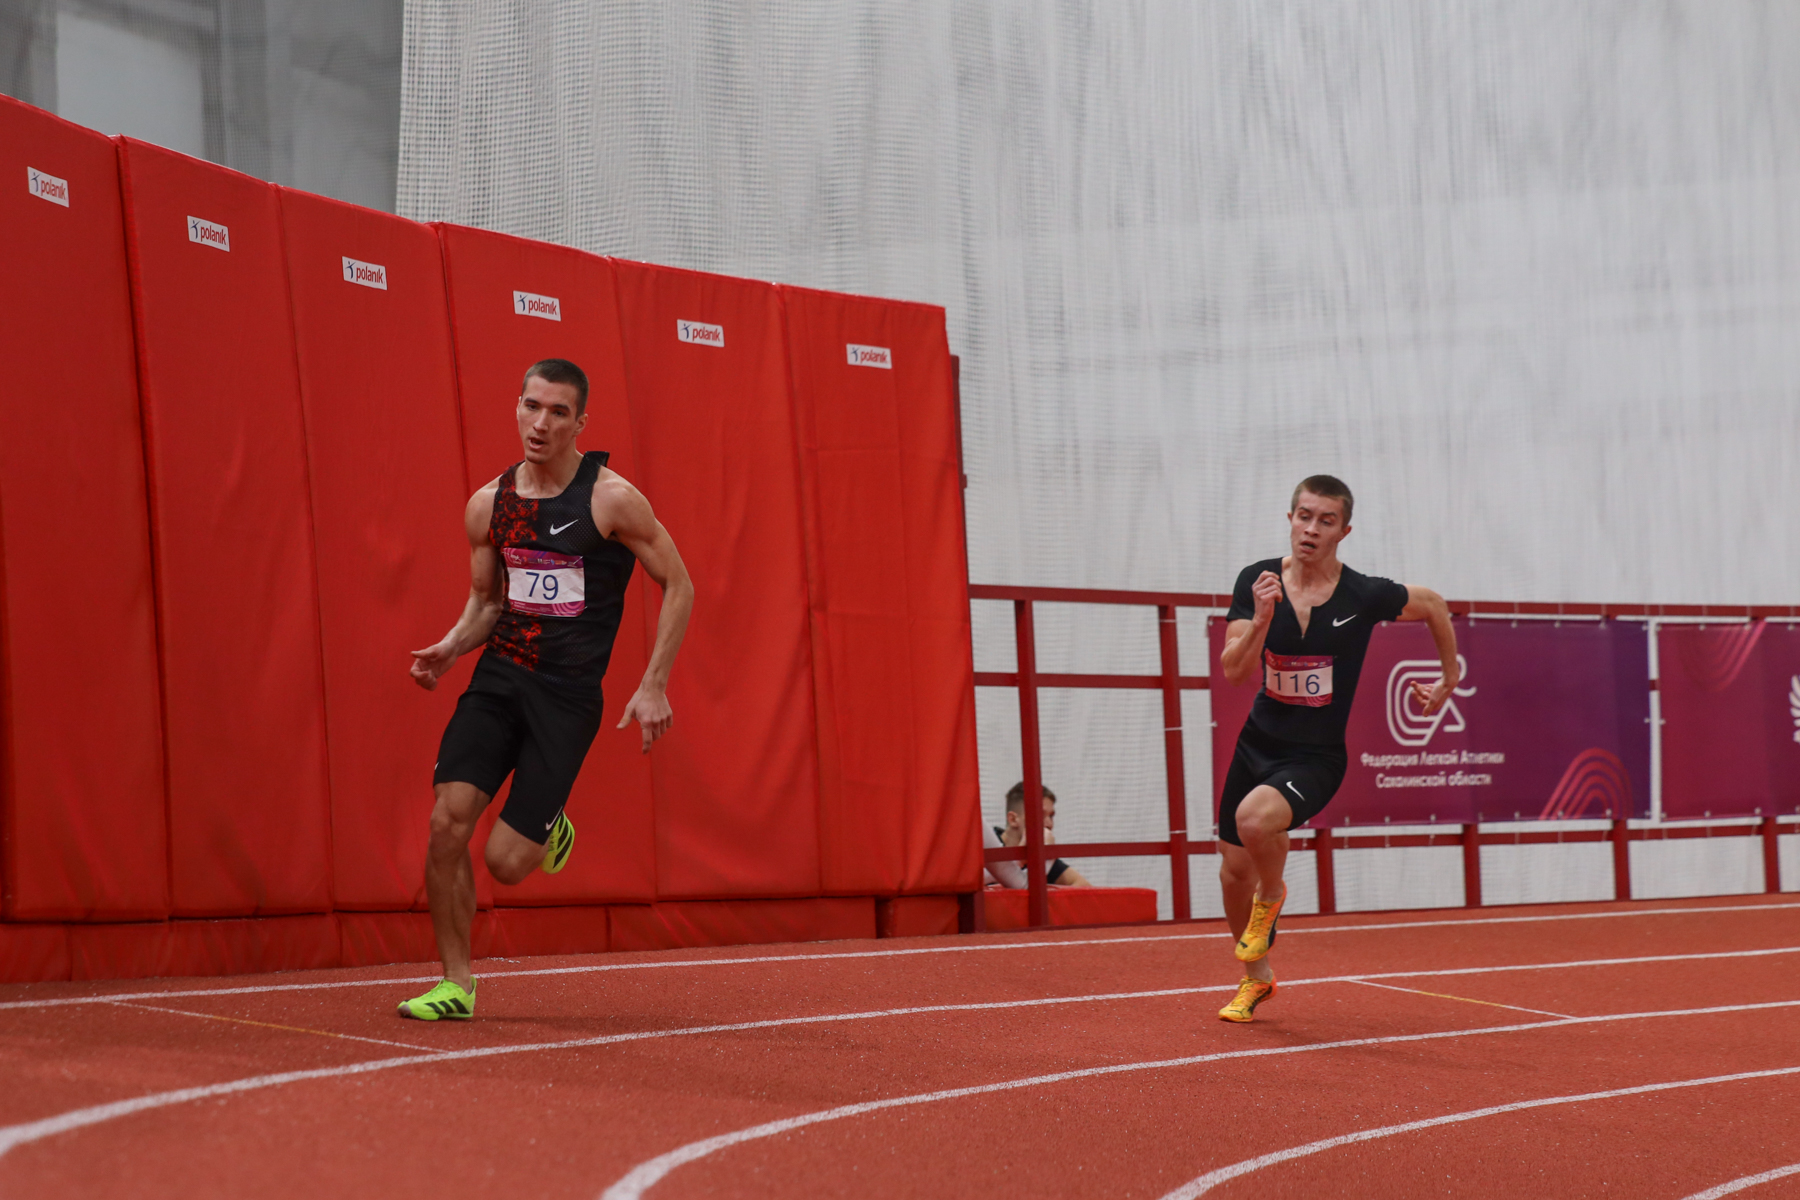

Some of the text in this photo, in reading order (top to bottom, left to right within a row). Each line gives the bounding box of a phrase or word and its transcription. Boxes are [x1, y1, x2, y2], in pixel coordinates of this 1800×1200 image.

[40, 178, 66, 201] polanik
[200, 225, 227, 245] polanik
[355, 265, 384, 285] polanik
[528, 297, 557, 316] polanik
[692, 326, 721, 342] polanik
[859, 348, 888, 364] polanik
[525, 571, 559, 601] 79
[1273, 671, 1320, 695] 116
[1360, 752, 1418, 770] Федерация
[1460, 750, 1505, 765] Атлетики
[1375, 770, 1492, 789] Сахалинской области
